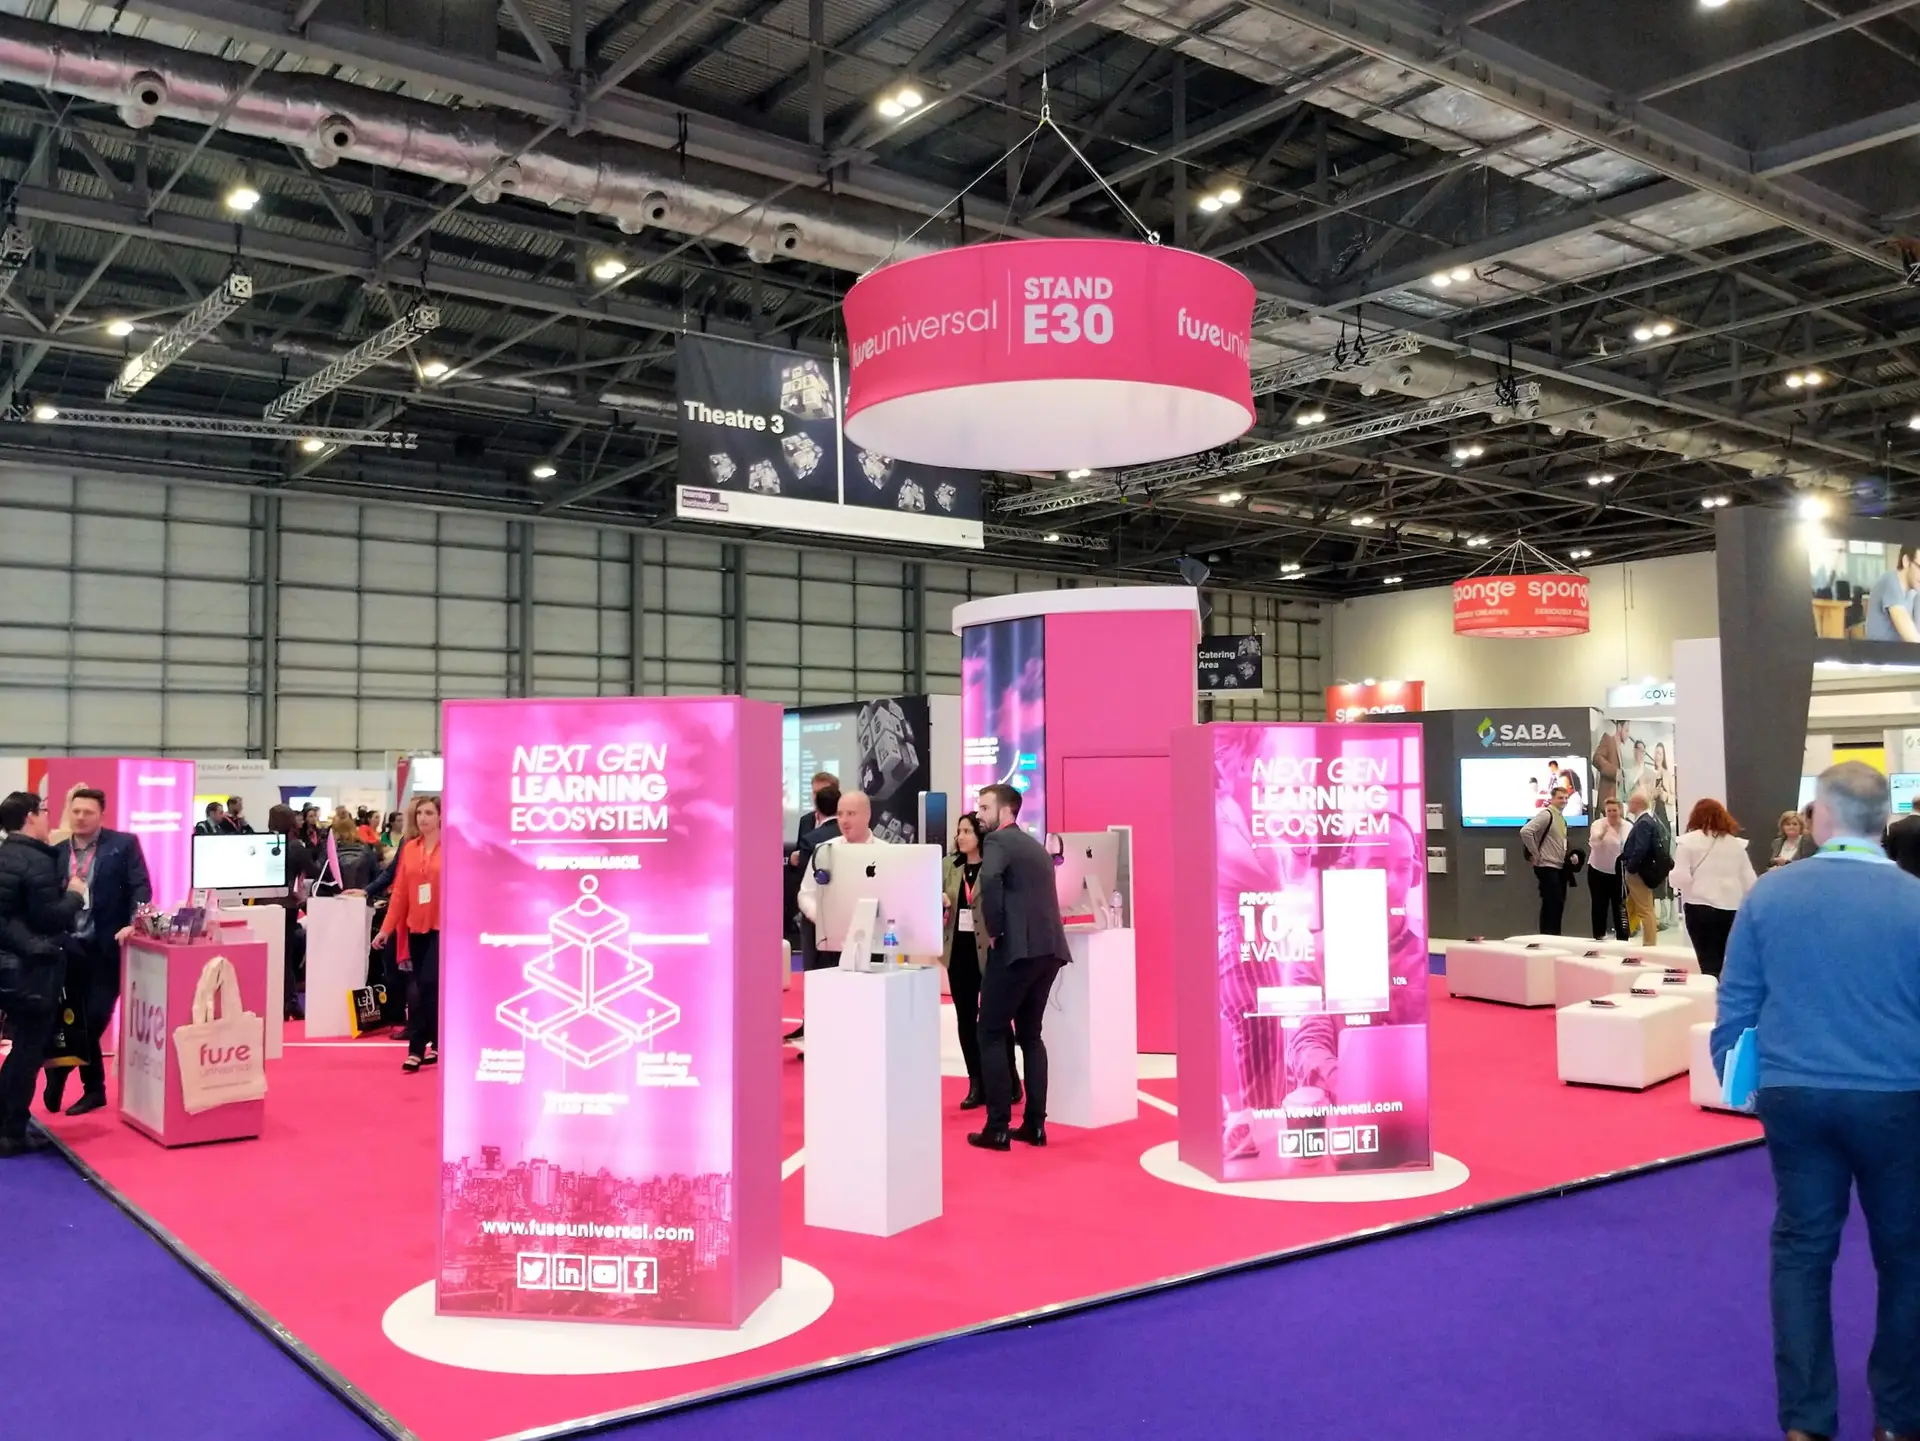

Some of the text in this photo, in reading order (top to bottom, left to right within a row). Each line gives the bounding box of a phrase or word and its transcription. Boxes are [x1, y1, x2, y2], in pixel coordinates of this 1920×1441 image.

[1024, 277, 1113, 300] STAND
[1023, 303, 1114, 344] E30
[683, 400, 785, 434] Theatre 3
[1454, 580, 1517, 608] ponge
[1198, 650, 1236, 660] Catering
[1198, 661, 1220, 669] Area
[1500, 723, 1564, 741] SABA
[512, 743, 668, 774] NEXT GEN
[1251, 757, 1388, 783] NEXT GEN
[511, 773, 668, 803] LEARNING
[1251, 785, 1388, 811] LEARNING
[511, 804, 668, 832] ECOSYSTEM
[1251, 813, 1390, 836] ECOSYSTEM
[1250, 942, 1316, 963] VALUE
[200, 1042, 252, 1067] fuse
[481, 1218, 695, 1242] www.fuseuniversal.com
